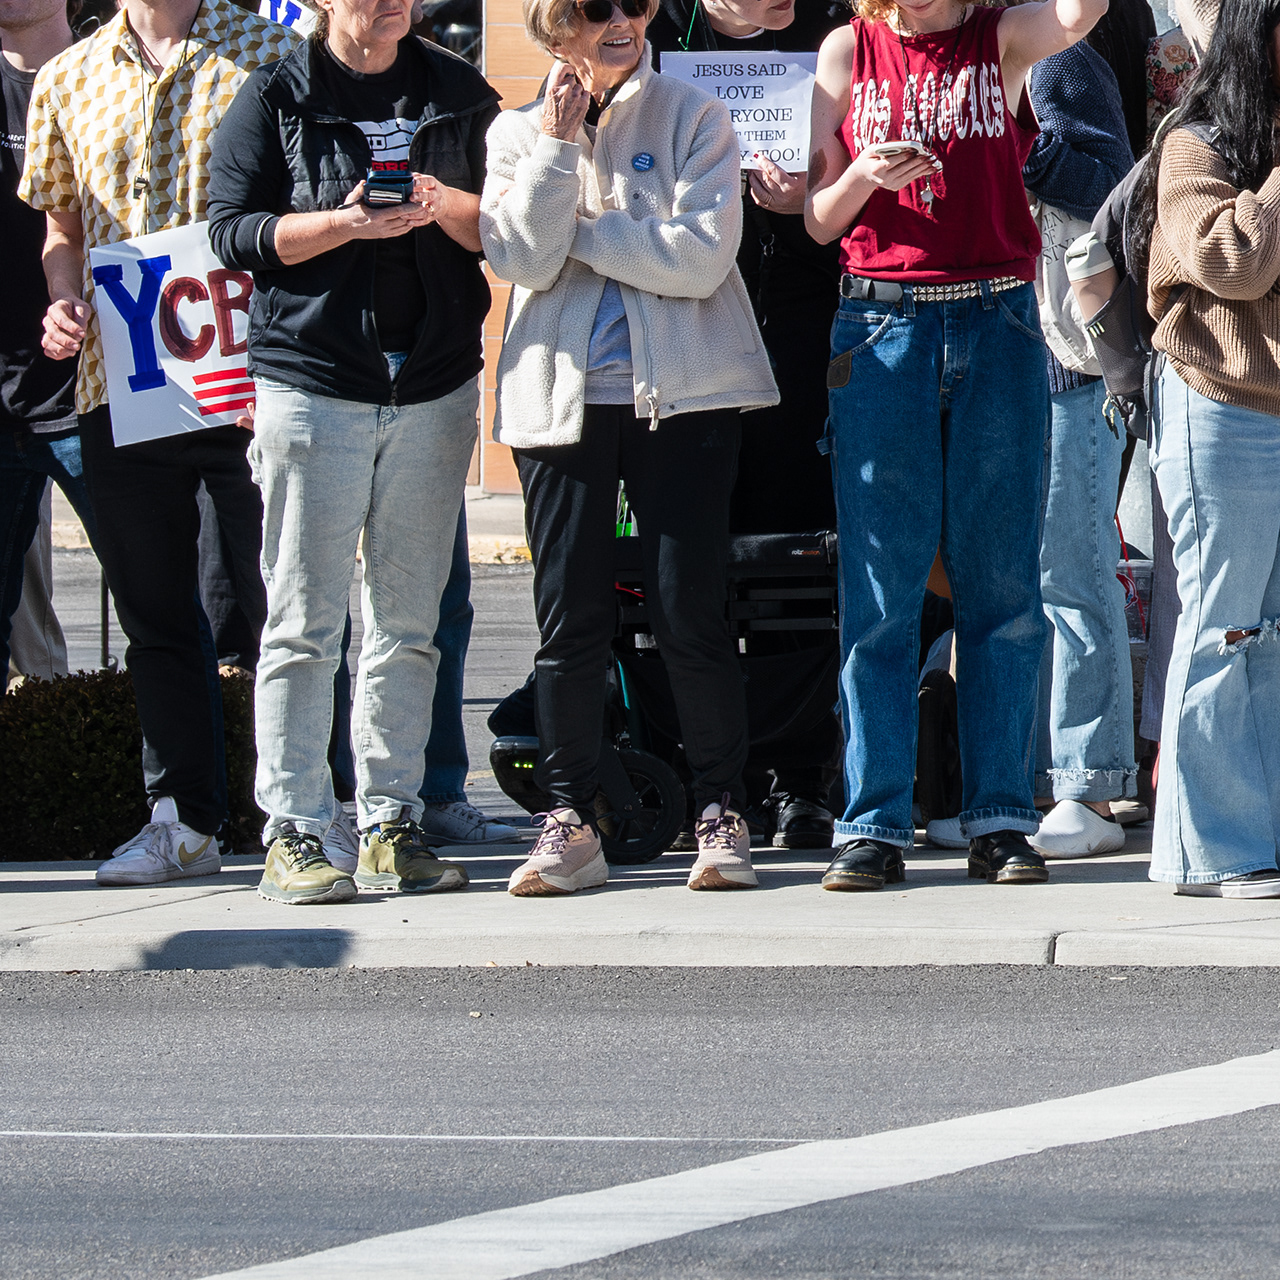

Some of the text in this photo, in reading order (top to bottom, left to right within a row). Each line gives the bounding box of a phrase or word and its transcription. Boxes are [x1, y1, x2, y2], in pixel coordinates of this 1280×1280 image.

[692, 63, 787, 78] JESUS SAID
[715, 86, 764, 99] LOVE
[730, 108, 792, 123] RYONE
[745, 130, 786, 141] THEM
